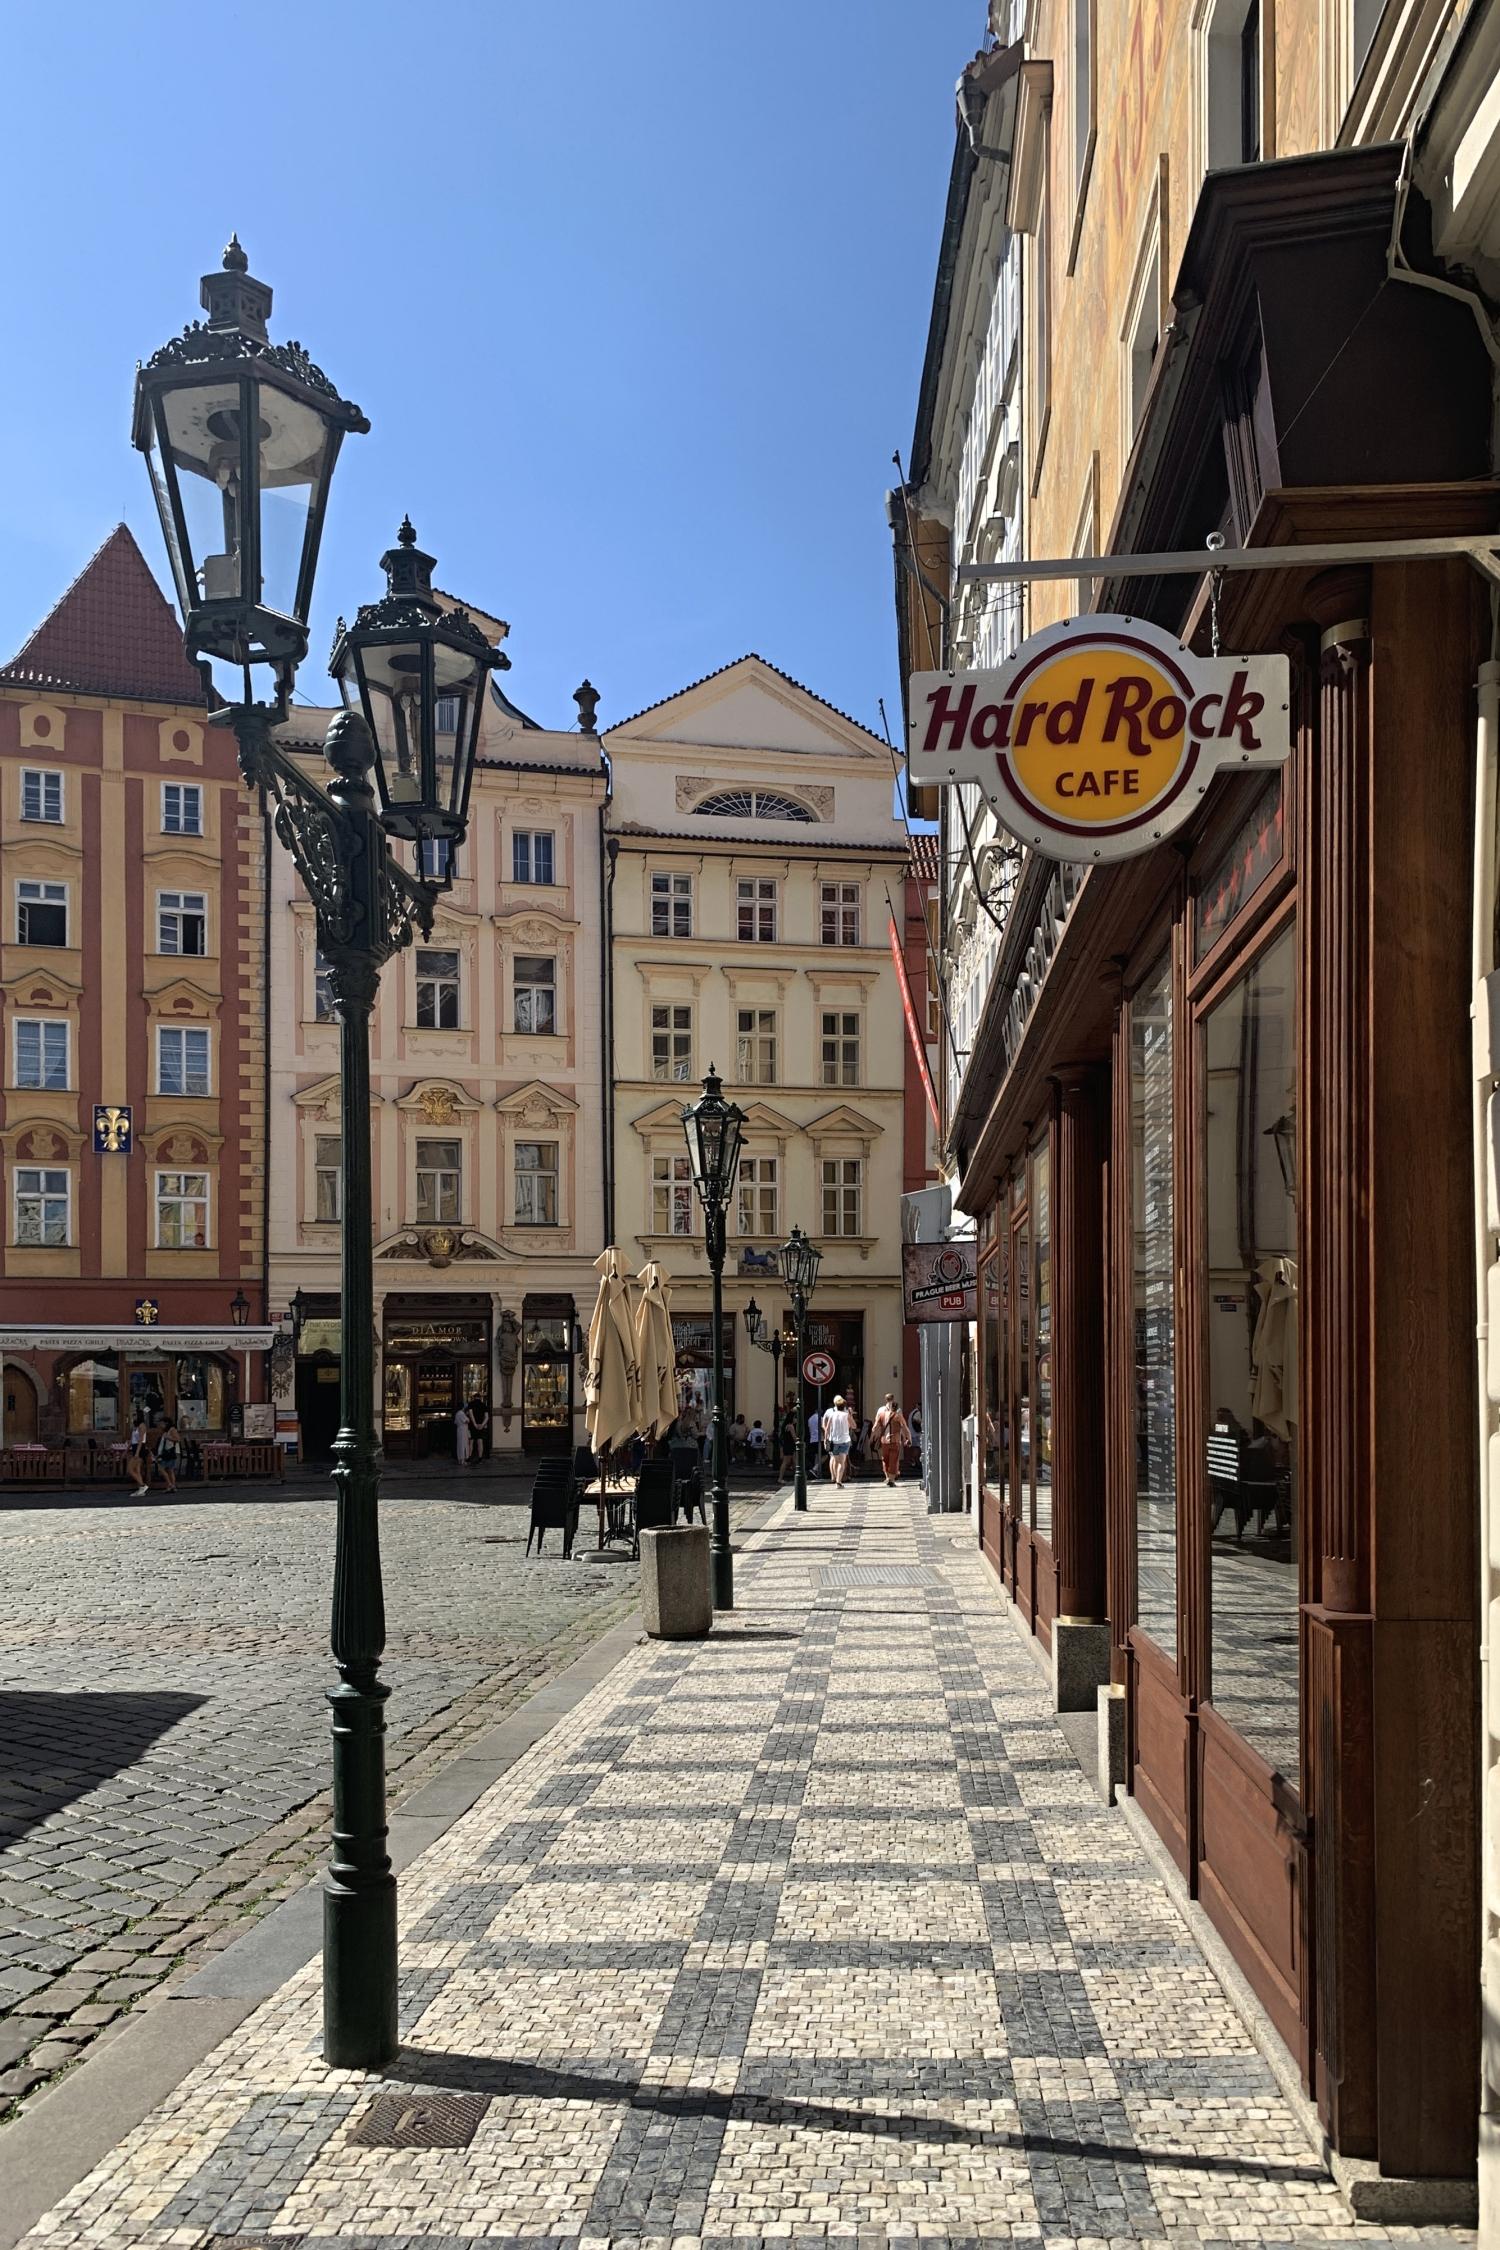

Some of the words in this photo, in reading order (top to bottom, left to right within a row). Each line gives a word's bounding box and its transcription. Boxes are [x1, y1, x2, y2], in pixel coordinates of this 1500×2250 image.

[922, 678, 1096, 752] Hard
[1101, 671, 1265, 757] Rock
[1055, 768, 1140, 798] CAFE
[915, 1287, 945, 1299] PRAGUE
[945, 1283, 961, 1293] BEER
[943, 1296, 962, 1306] PUB
